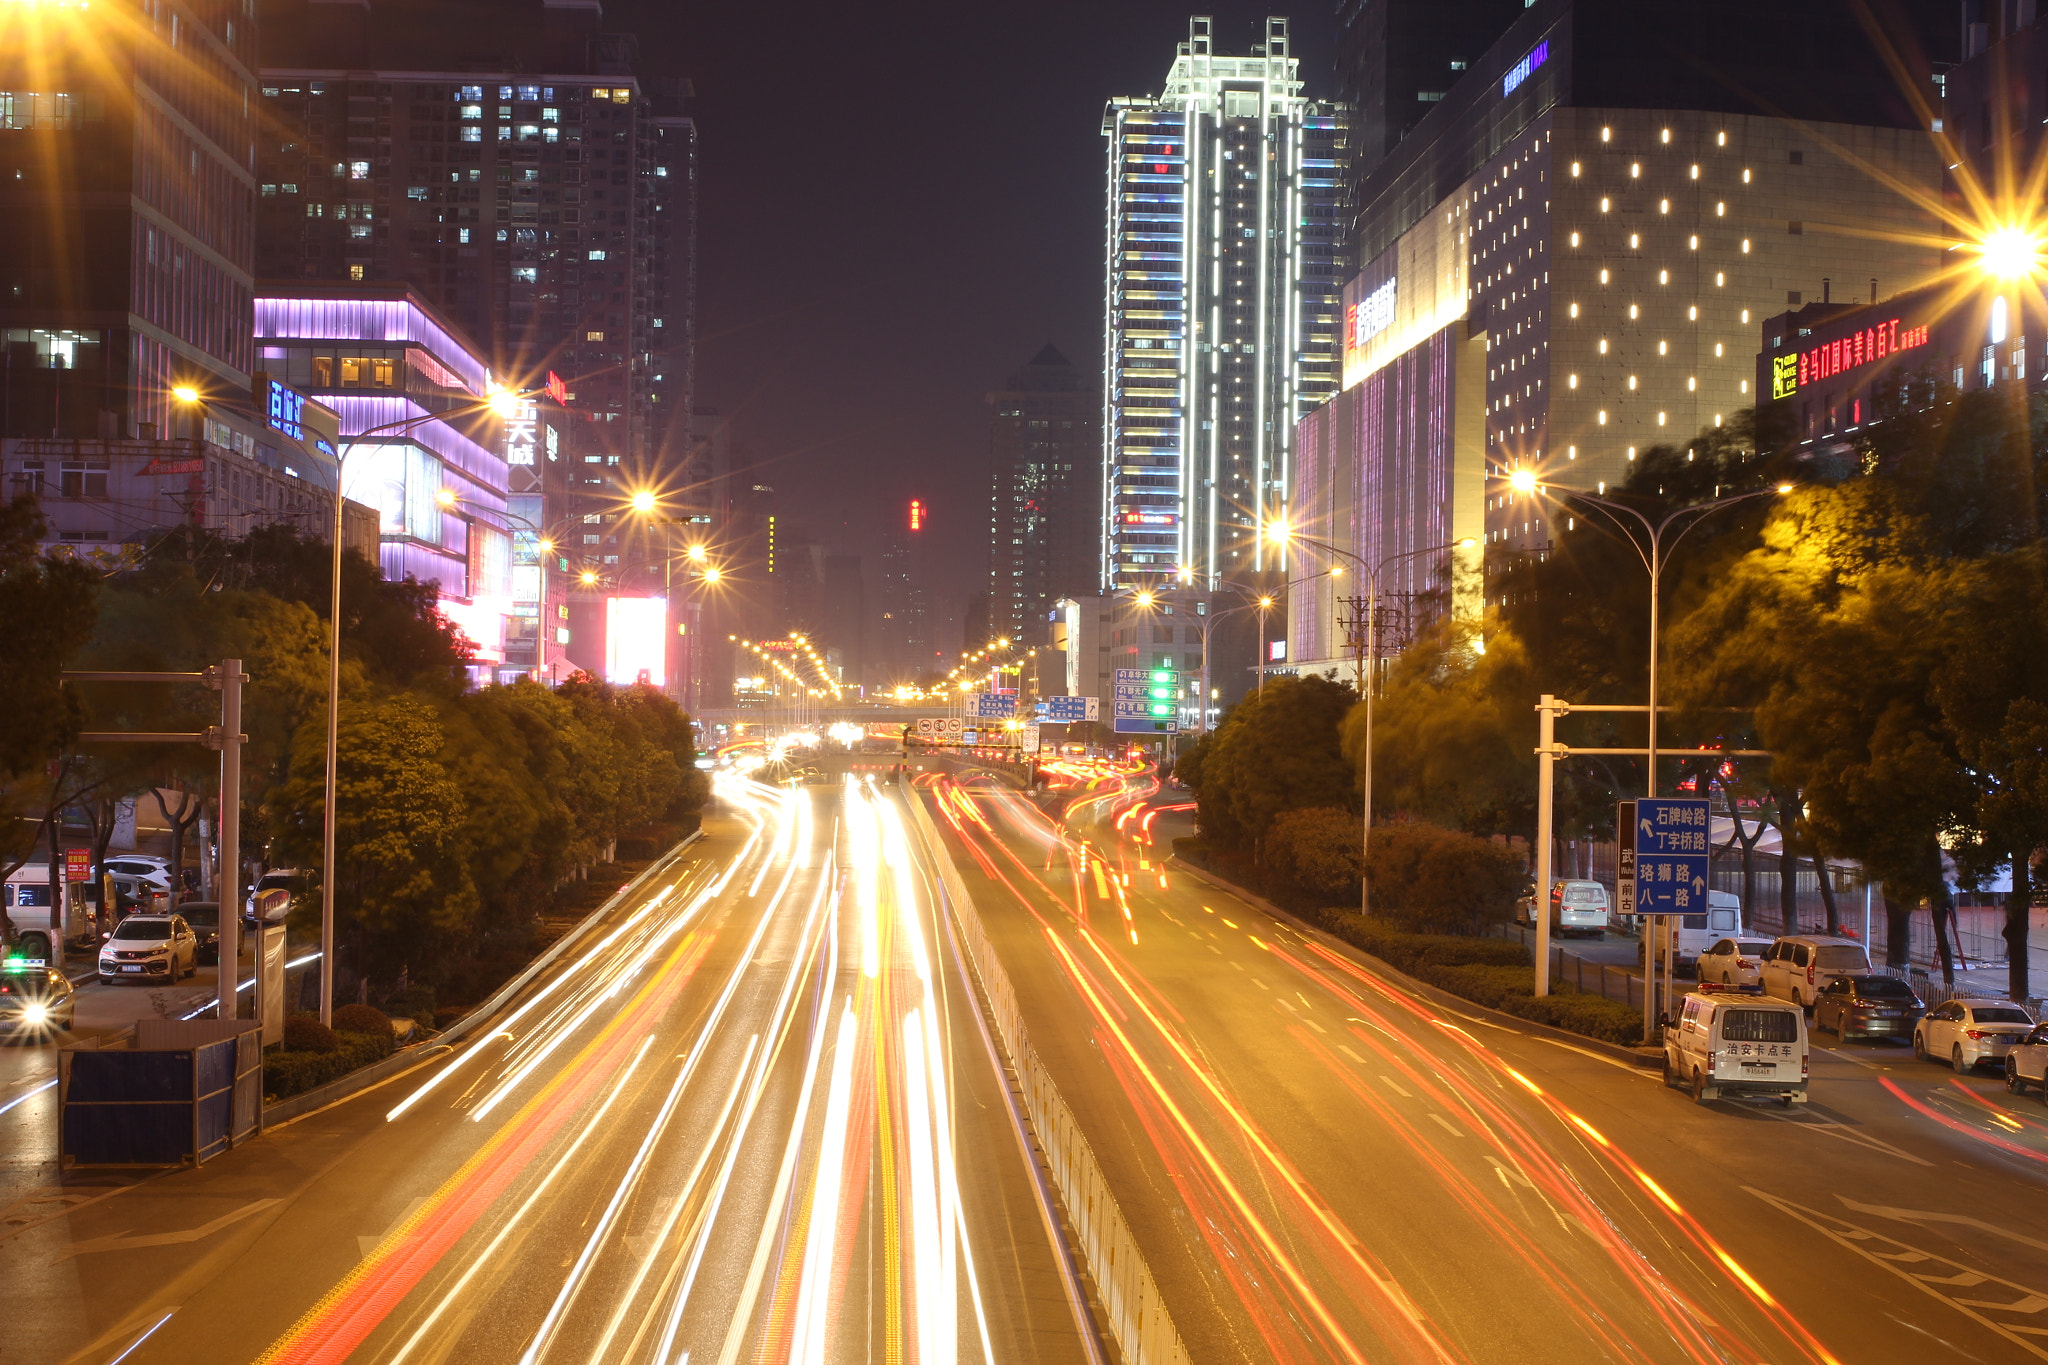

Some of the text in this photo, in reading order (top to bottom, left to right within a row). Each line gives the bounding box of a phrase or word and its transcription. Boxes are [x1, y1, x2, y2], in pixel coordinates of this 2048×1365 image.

[1530, 39, 1549, 73] IMAX
[1800, 318, 1900, 386] 金马门国际美食百汇
[1656, 806, 1707, 826] 石牌岭路
[1656, 831, 1706, 850] 丁字桥路
[1640, 863, 1690, 882] 珞狮路
[1621, 883, 1633, 896] 前
[1640, 887, 1690, 907] 八一路
[1621, 898, 1633, 910] 古
[1727, 1043, 1792, 1057] 治安卡点车
